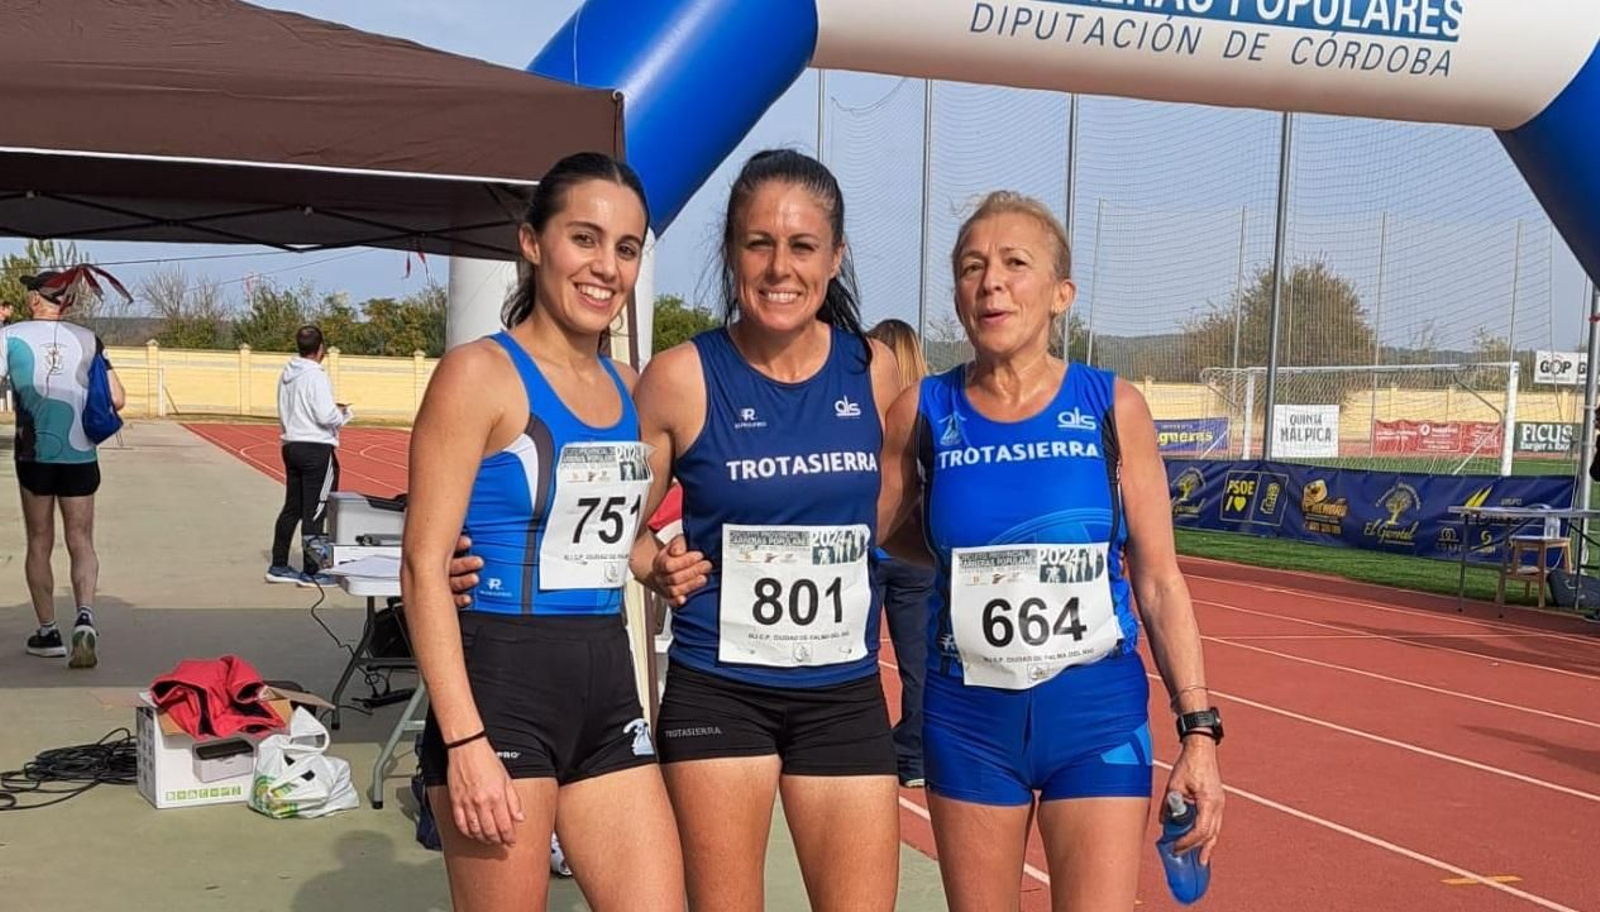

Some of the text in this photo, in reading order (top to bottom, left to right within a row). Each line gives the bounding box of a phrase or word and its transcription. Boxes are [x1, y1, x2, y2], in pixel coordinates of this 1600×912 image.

[969, 3, 1453, 77] DIPUTACIÓN DE CÓRDOBA
[1280, 427, 1332, 442] MALPICA
[1289, 414, 1323, 426] QUINTA
[1521, 424, 1573, 443] FICUS
[726, 452, 878, 481] TROTASIERRA
[938, 441, 1100, 470] TROTASIERRA
[1226, 480, 1256, 495] PSOE
[572, 494, 642, 544] 751
[1039, 548, 1079, 565] 2024
[752, 576, 843, 627] 801
[982, 596, 1087, 648] 664
